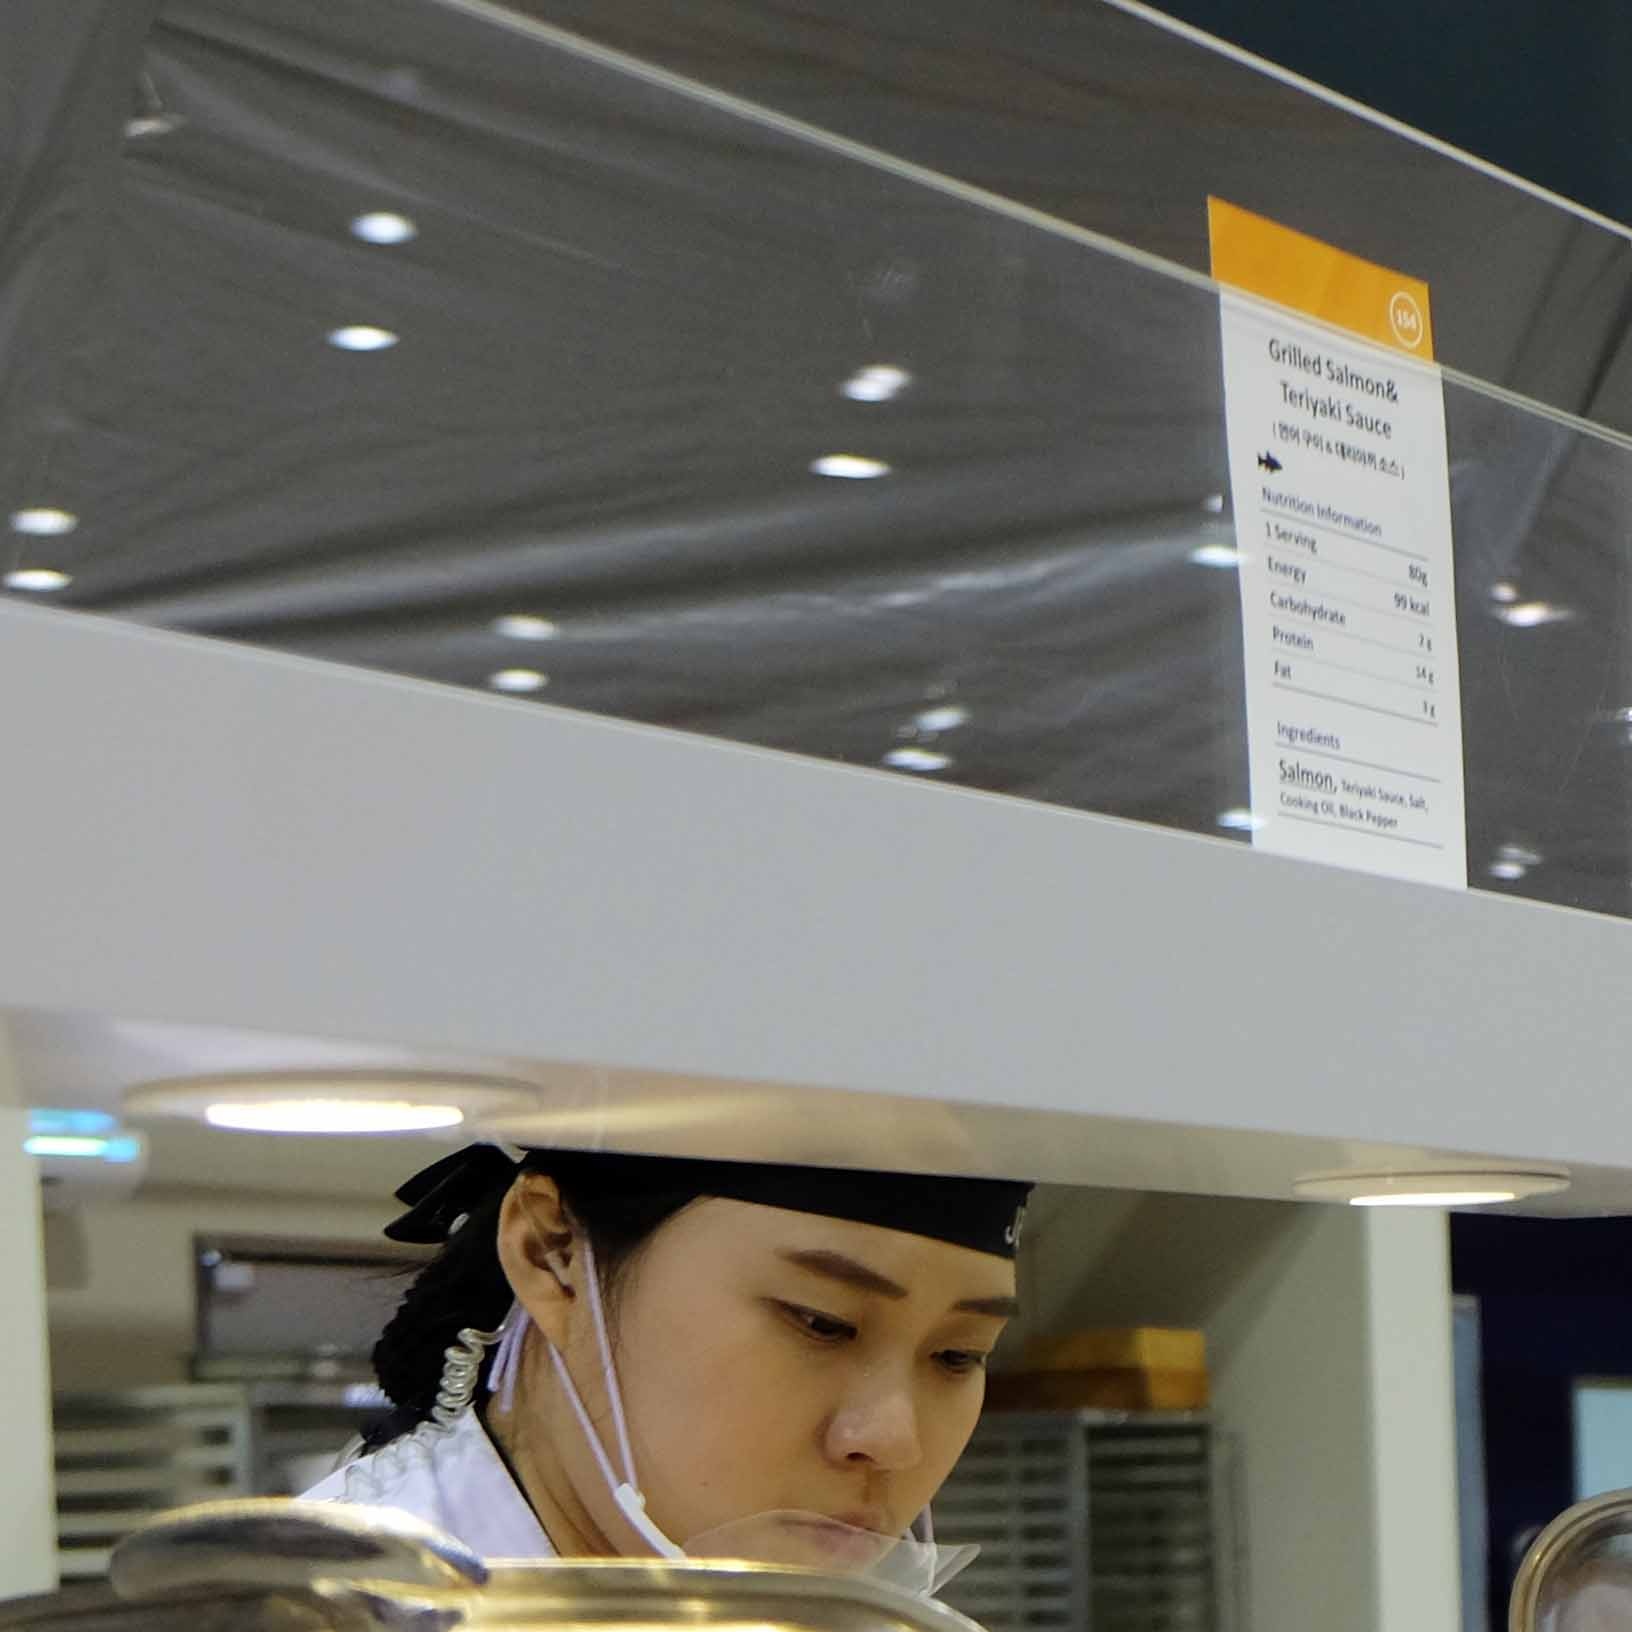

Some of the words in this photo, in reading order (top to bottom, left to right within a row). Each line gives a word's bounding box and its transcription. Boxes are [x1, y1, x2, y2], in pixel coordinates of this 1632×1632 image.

[1268, 338, 1321, 376] Grilled
[1326, 359, 1398, 403] Salmon&
[1280, 380, 1342, 422] Teriyaki
[1346, 404, 1391, 439] Sauce
[1262, 487, 1314, 515] Nutrition
[1317, 503, 1382, 537] Information
[1275, 525, 1317, 553] Serving
[1268, 556, 1307, 584] Energy
[1270, 591, 1346, 626] Carbohydrate
[1409, 597, 1430, 617] kcal
[1272, 625, 1314, 650] Protein
[1274, 660, 1292, 680] Fat
[1277, 720, 1341, 750] Ingredients
[1279, 759, 1338, 793] Salmon,
[1342, 779, 1377, 801] Teriyaki
[1280, 791, 1319, 815] Cooking
[1339, 803, 1364, 821] Black
[1366, 808, 1399, 830] Pepper
